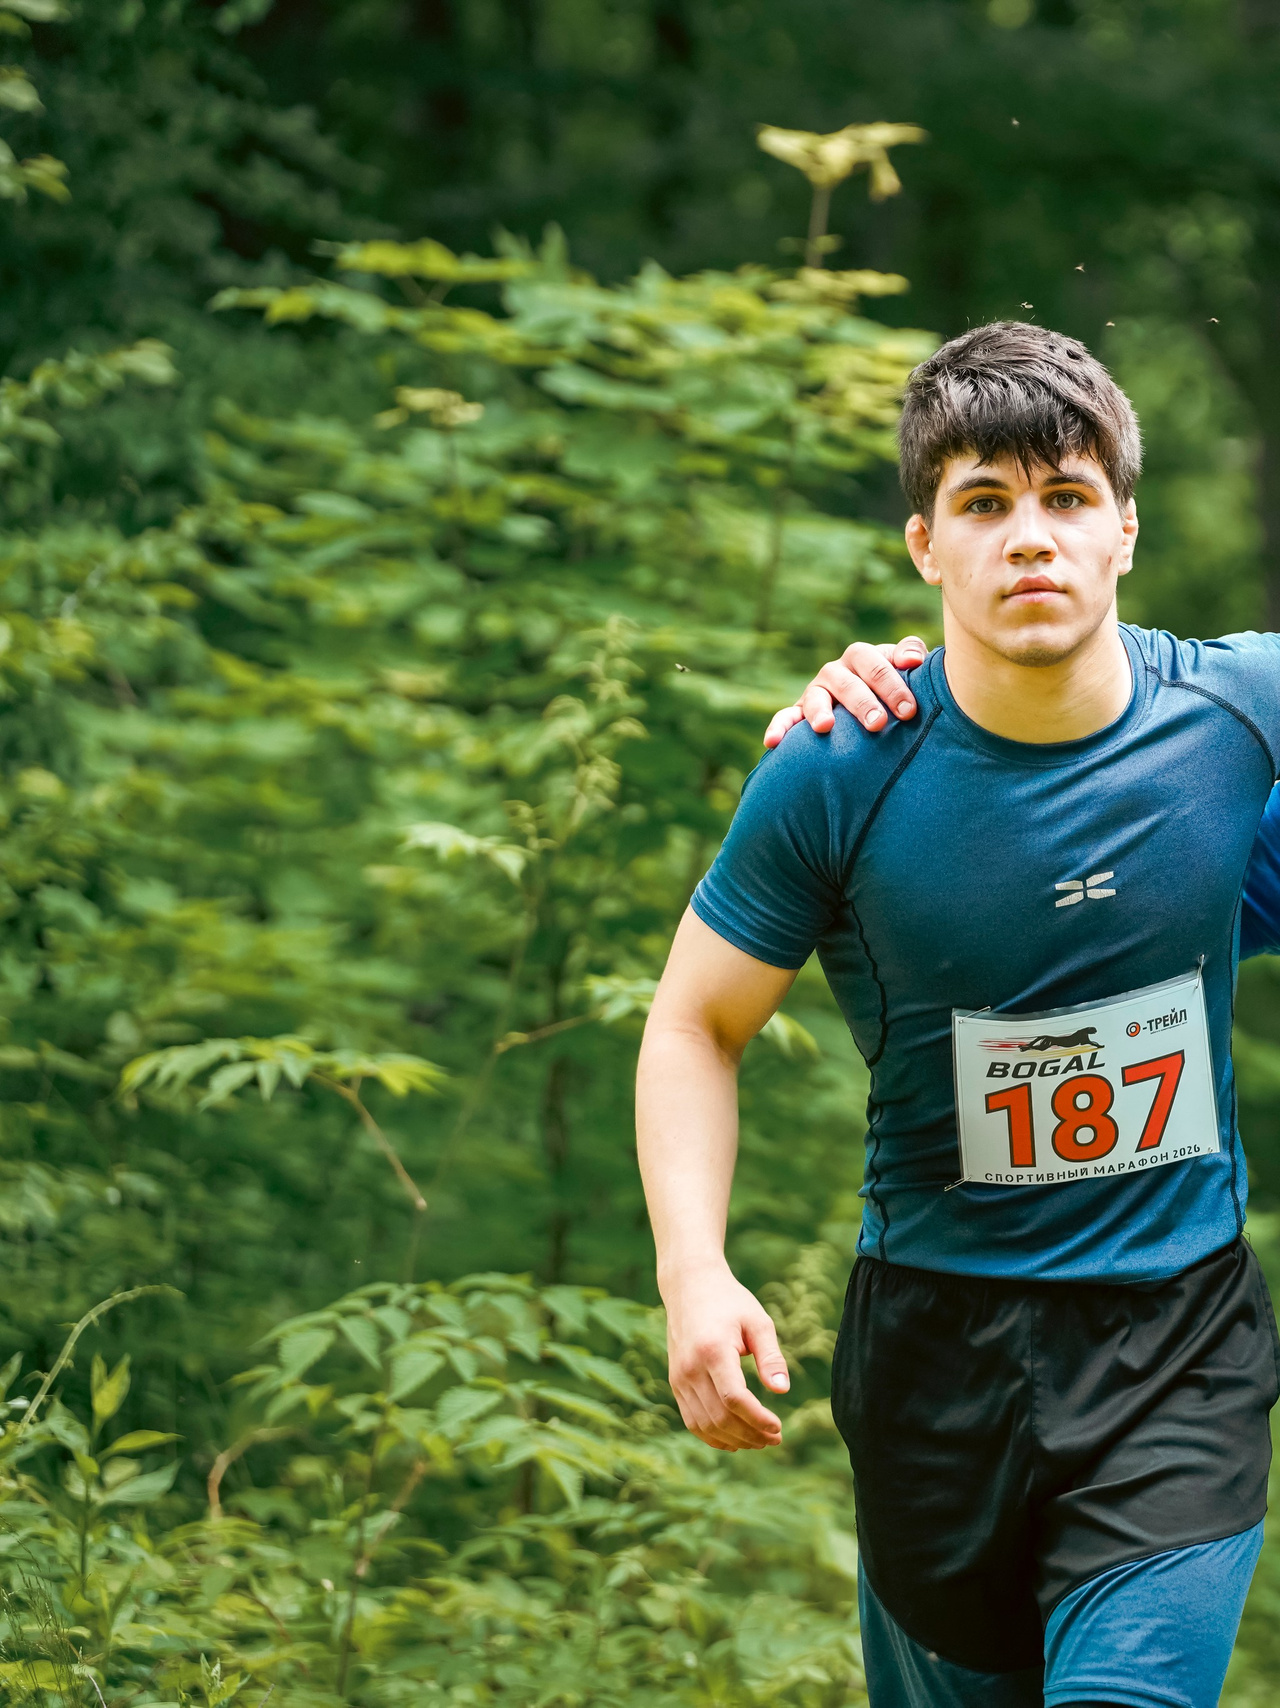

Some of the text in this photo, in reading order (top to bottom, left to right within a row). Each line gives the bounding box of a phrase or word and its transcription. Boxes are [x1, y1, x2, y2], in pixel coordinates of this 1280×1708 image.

[985, 1051, 1106, 1079] BOGAL
[984, 1049, 1186, 1168] 187
[984, 1144, 1201, 1183] СПОРТИВНЫЙ МАРАФОН 2026
